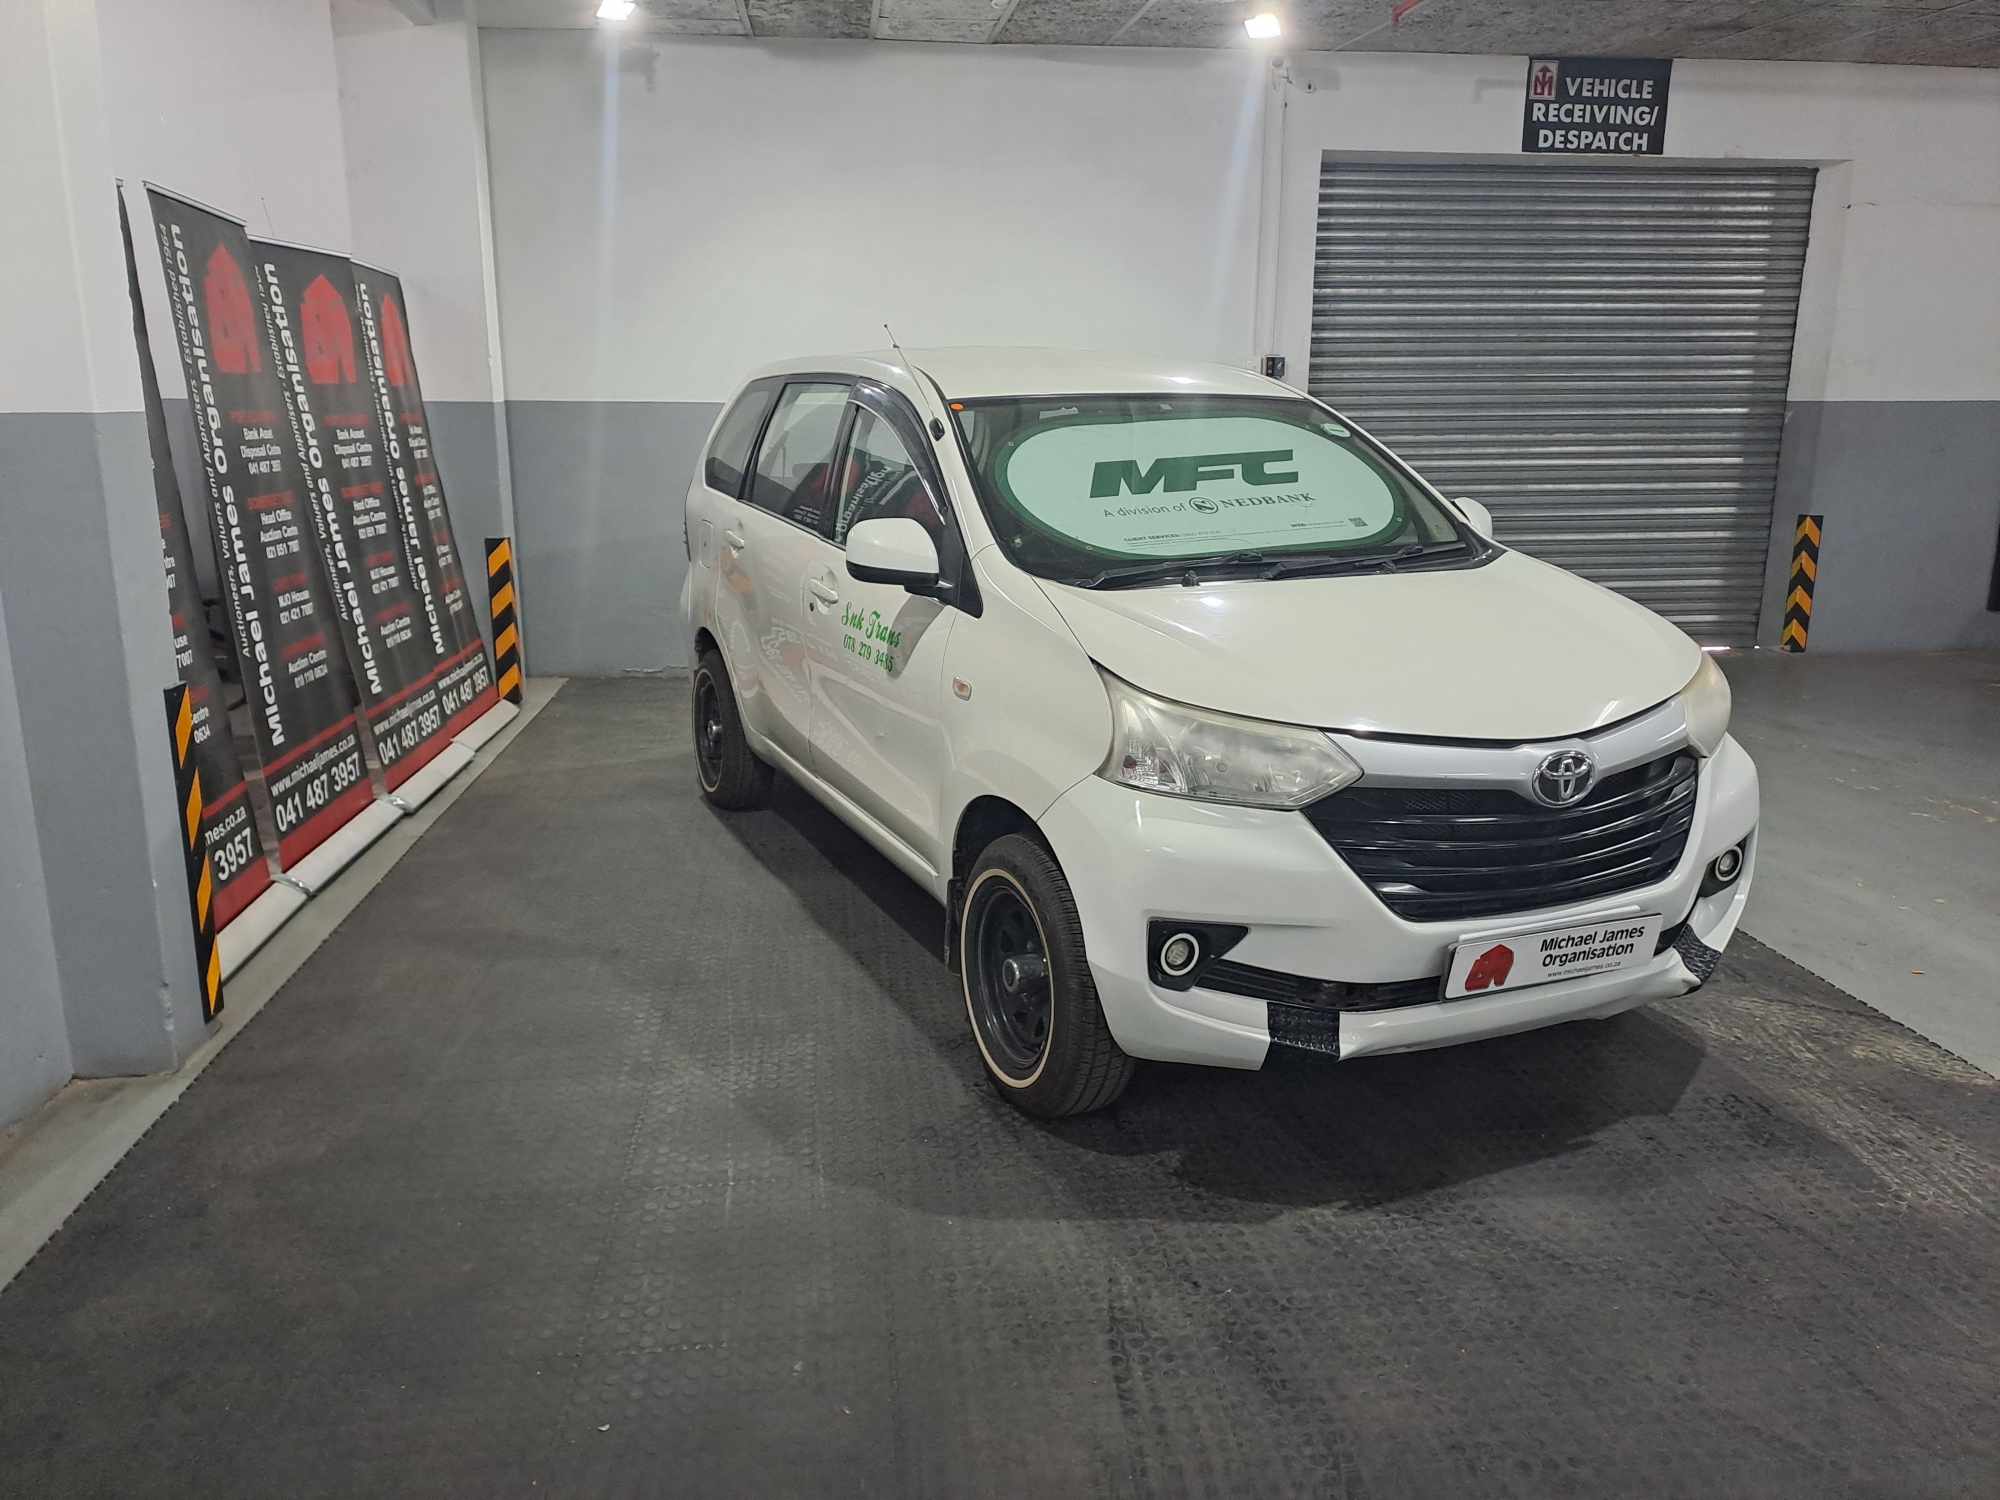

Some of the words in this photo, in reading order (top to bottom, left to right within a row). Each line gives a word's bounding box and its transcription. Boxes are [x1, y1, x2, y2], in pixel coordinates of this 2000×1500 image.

[1532, 103, 1659, 126] RECEIVING/
[1565, 77, 1655, 100] VEHICLE
[1538, 129, 1648, 151] DESPATCH
[168, 268, 193, 364] Established
[170, 224, 228, 474] Organisation
[264, 263, 323, 469] Organisation
[360, 283, 400, 460] Organisation
[190, 378, 212, 464] Appraisers
[284, 391, 306, 460] Appraisers
[205, 466, 219, 498] and
[300, 462, 314, 489] and
[1089, 449, 1299, 499] MFC
[214, 501, 230, 559] Valuers
[310, 491, 327, 539] Valuers
[317, 477, 351, 573] James
[395, 466, 421, 550] James
[1103, 508, 1115, 517] A
[1117, 504, 1171, 516] division
[1173, 502, 1188, 512] of
[1218, 492, 1316, 509] NEDBANK
[222, 485, 255, 600] James
[413, 556, 445, 655] Michael
[865, 610, 902, 648] Trans
[342, 581, 383, 695] Michael
[245, 610, 285, 746] Michael
[441, 689, 460, 715] 041
[270, 733, 356, 797] www.michaeljames.co.za
[378, 734, 401, 765] 041
[401, 723, 419, 750] 487
[418, 705, 441, 737] 3957
[275, 792, 304, 832] 041
[305, 774, 330, 810] 487
[331, 752, 361, 791] 3957
[214, 826, 253, 881] 3957
[1540, 930, 1598, 952] Michael
[1598, 926, 1646, 944] James
[1542, 942, 1635, 967] Organisation
